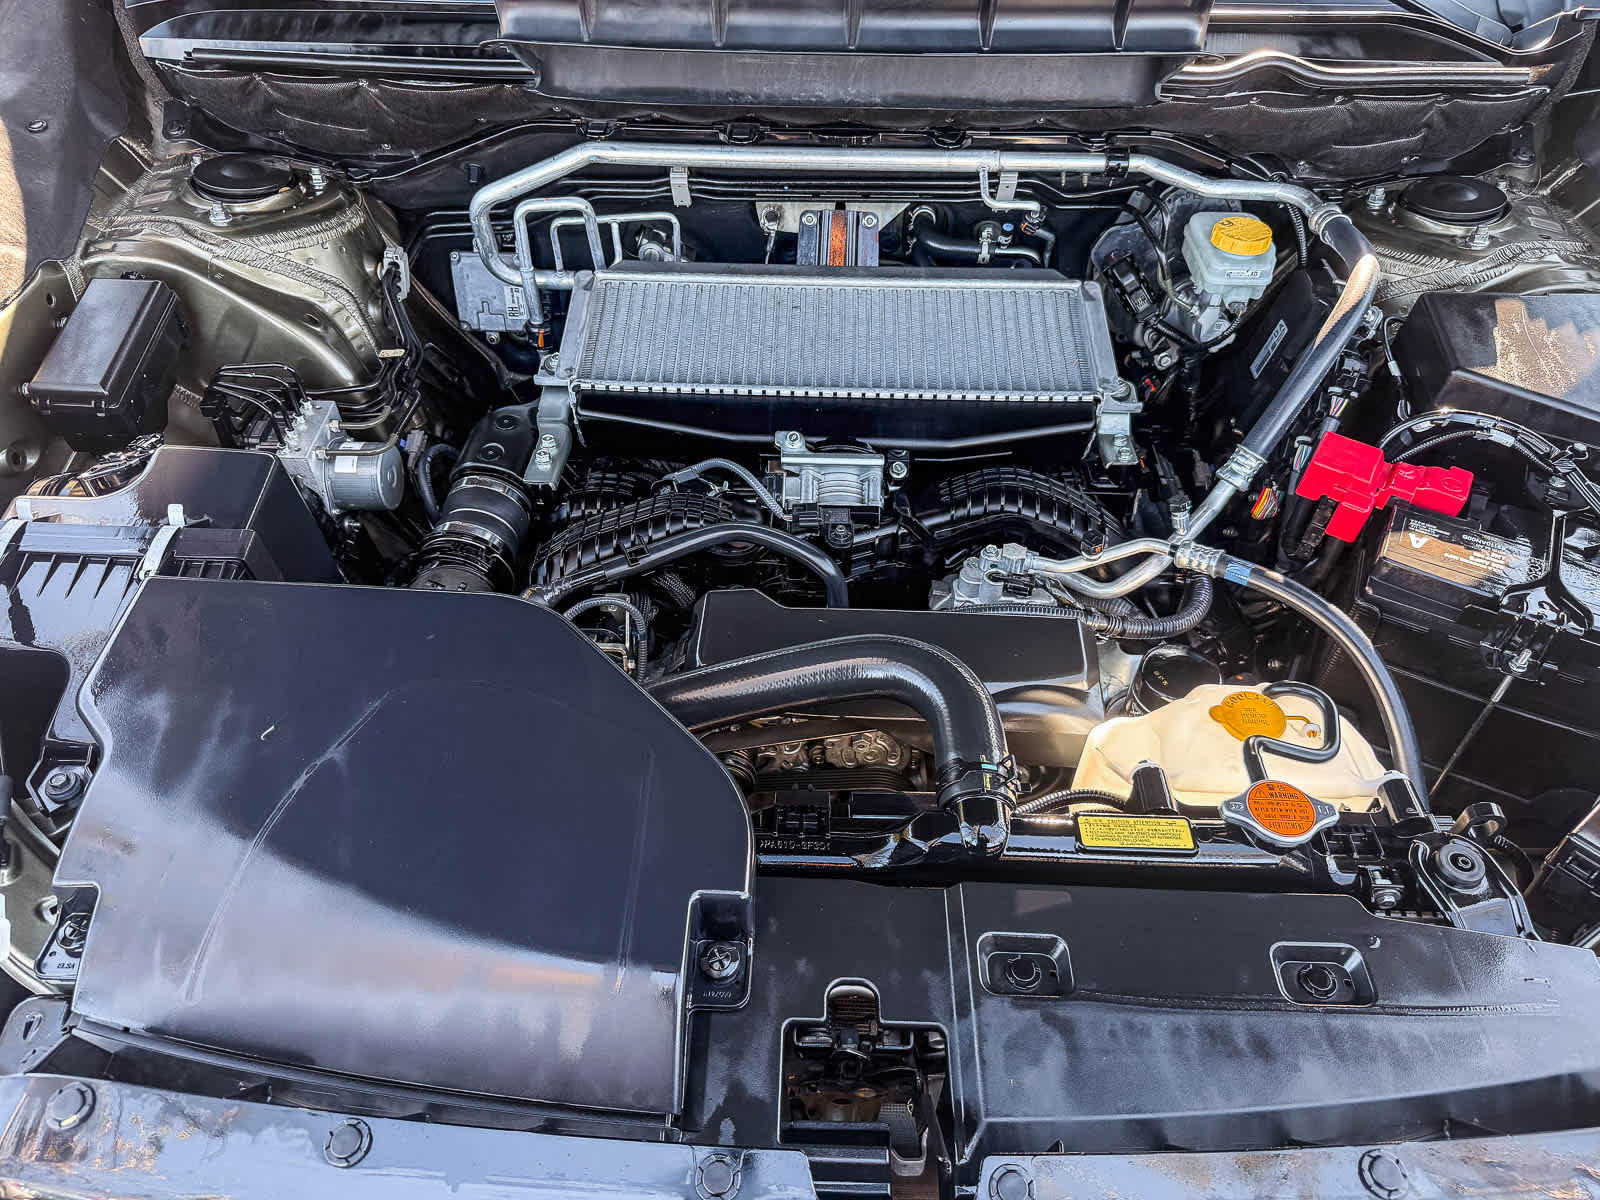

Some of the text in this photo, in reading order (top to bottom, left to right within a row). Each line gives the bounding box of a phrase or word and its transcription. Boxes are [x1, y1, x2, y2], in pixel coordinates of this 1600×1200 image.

[507, 306, 519, 317] RH
[1408, 532, 1430, 549] A
[1268, 791, 1299, 800] WARNING
